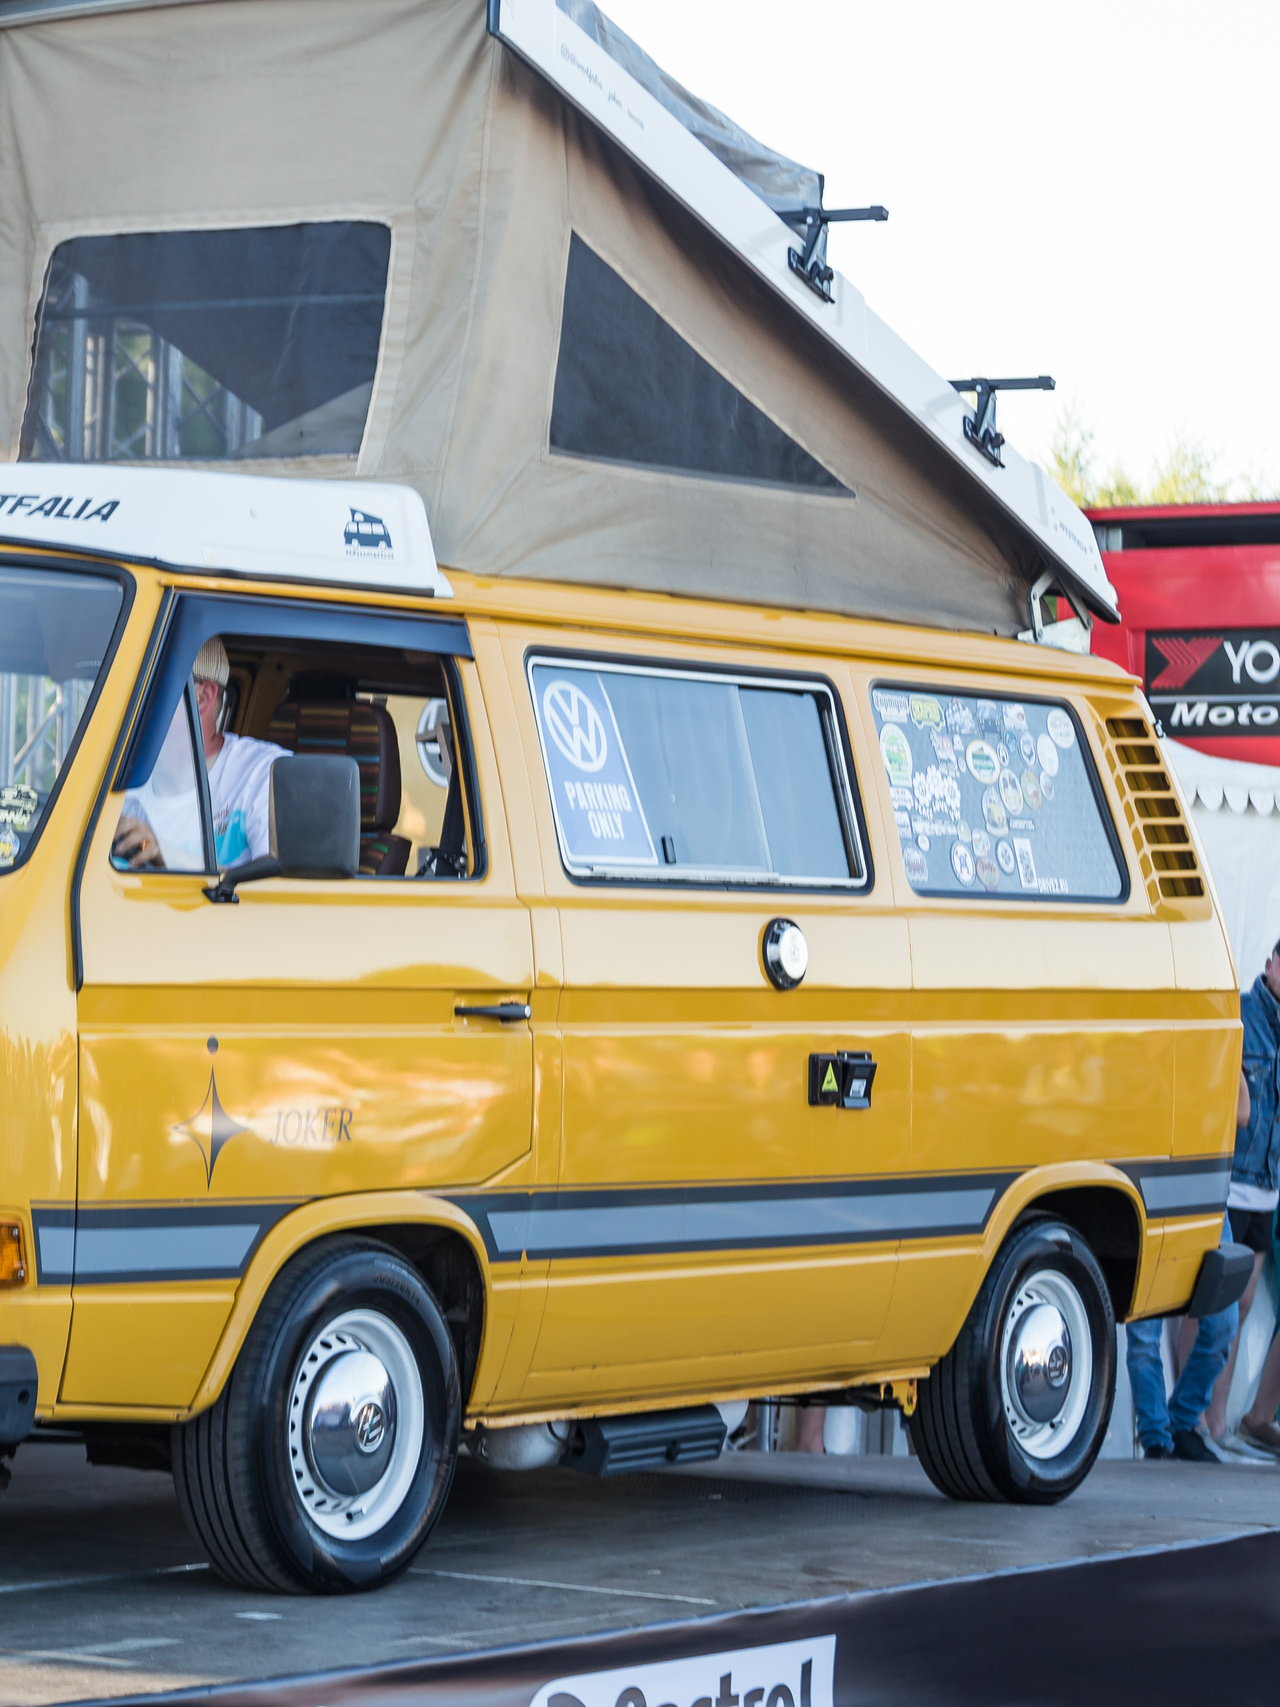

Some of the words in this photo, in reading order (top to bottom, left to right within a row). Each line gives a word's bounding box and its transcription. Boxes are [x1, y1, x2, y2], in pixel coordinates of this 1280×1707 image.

[1170, 700, 1280, 727] Moto
[564, 781, 632, 812] PARKING
[587, 811, 625, 840] ONLY
[270, 1107, 353, 1144] JOKER
